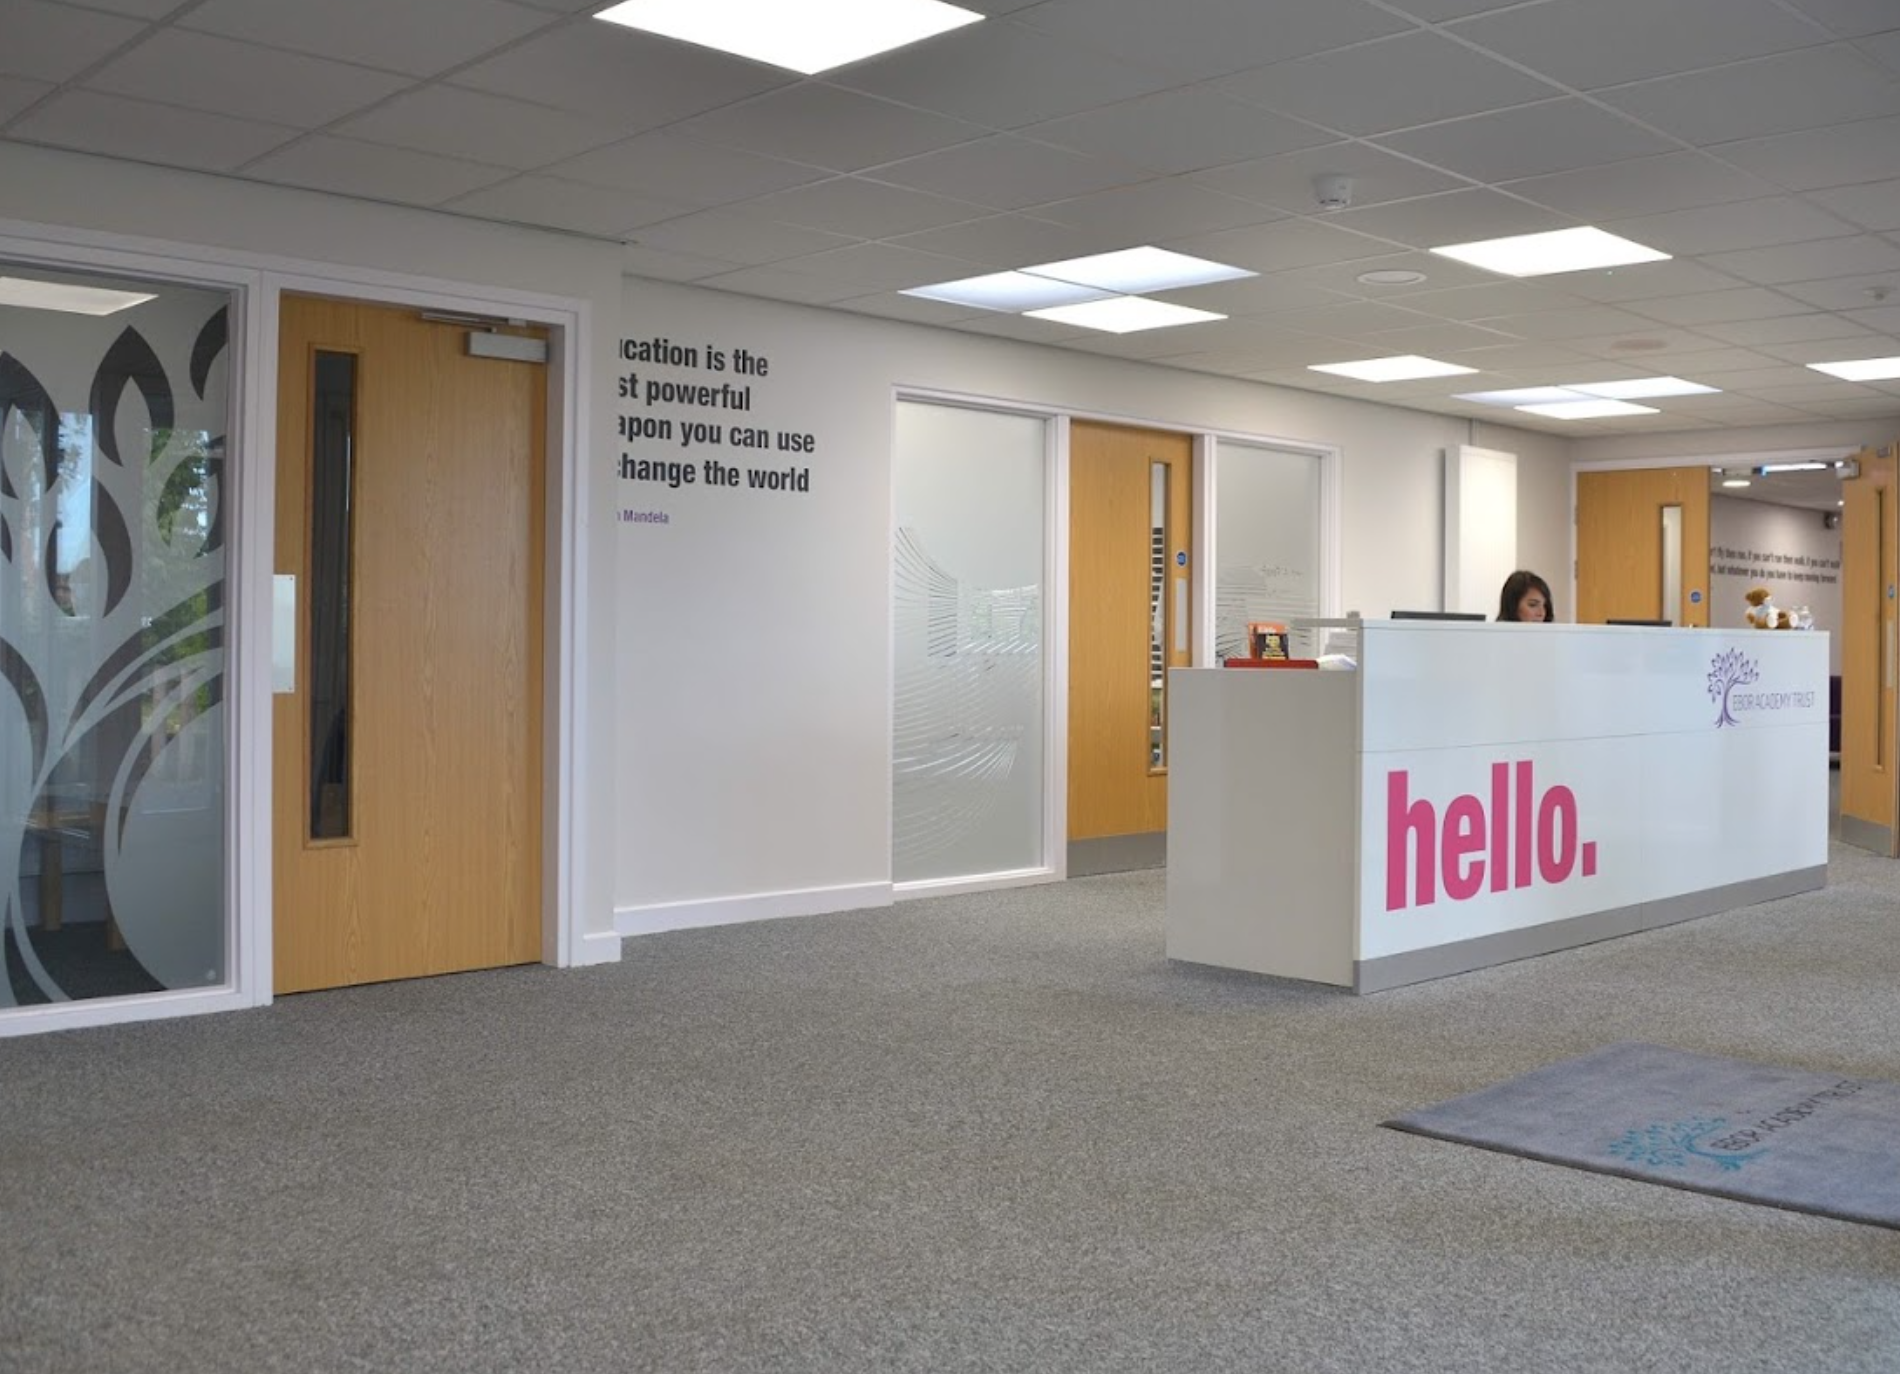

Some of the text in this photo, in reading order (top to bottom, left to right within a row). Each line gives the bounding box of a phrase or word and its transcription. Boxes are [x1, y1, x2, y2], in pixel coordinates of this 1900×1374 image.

[706, 346, 725, 371] is
[733, 349, 768, 377] the
[646, 379, 750, 411] powerful
[680, 421, 721, 447] you
[730, 426, 769, 449] can
[777, 431, 815, 454] use
[618, 452, 809, 493] hange the world
[623, 509, 669, 525] Mandela
[1386, 760, 1597, 912] hello.
